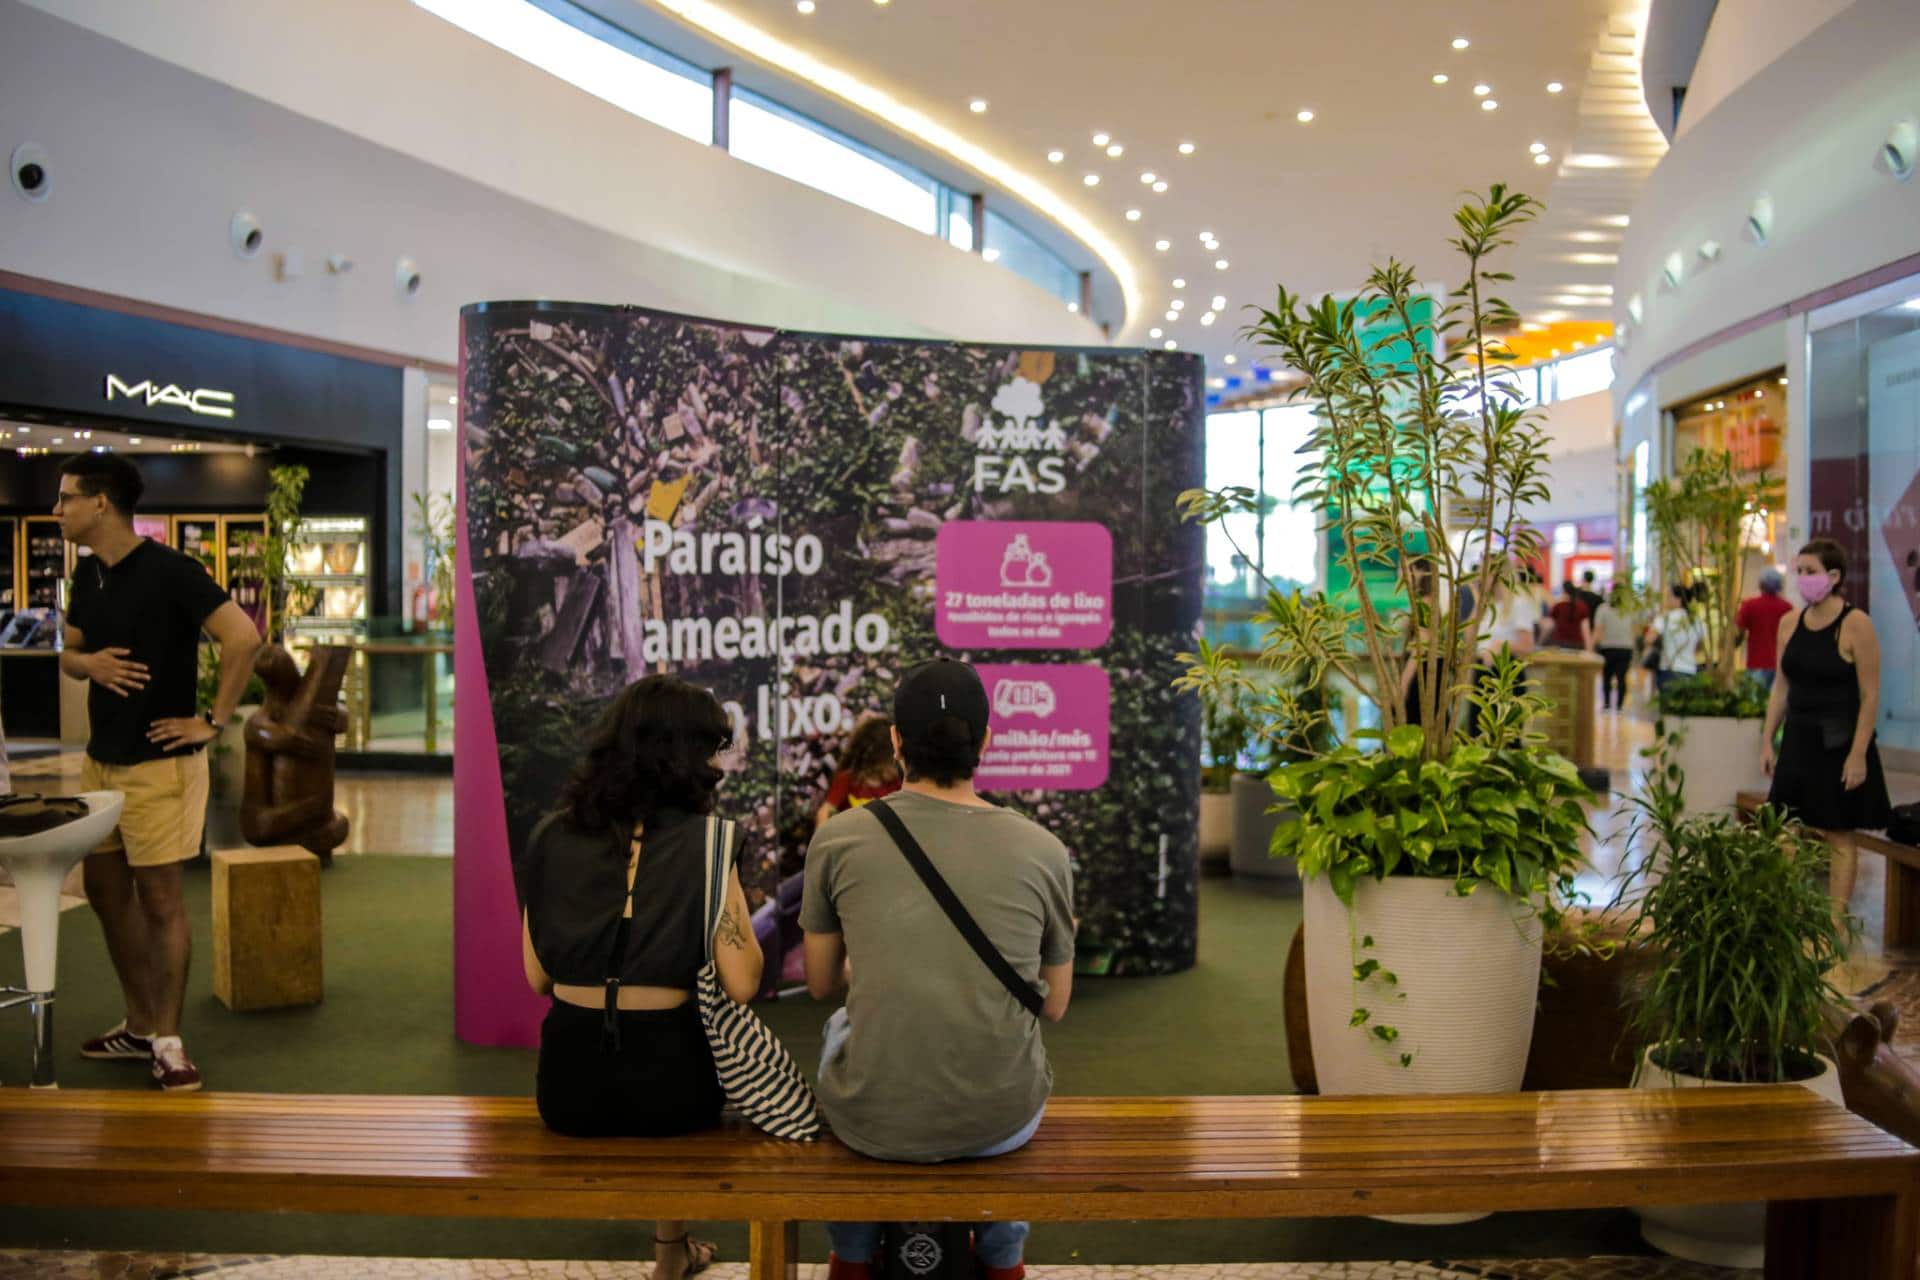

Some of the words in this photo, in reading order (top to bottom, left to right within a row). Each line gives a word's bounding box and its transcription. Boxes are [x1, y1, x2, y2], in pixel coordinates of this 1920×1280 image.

[974, 455, 1066, 494] FAS
[643, 515, 823, 577] Paraíso
[944, 592, 963, 608] 27
[966, 592, 1046, 609] toneladas
[1050, 592, 1071, 609] de
[1074, 591, 1104, 609] lixo
[643, 600, 890, 673] ameaçado
[993, 728, 1092, 748] milhão/mês
